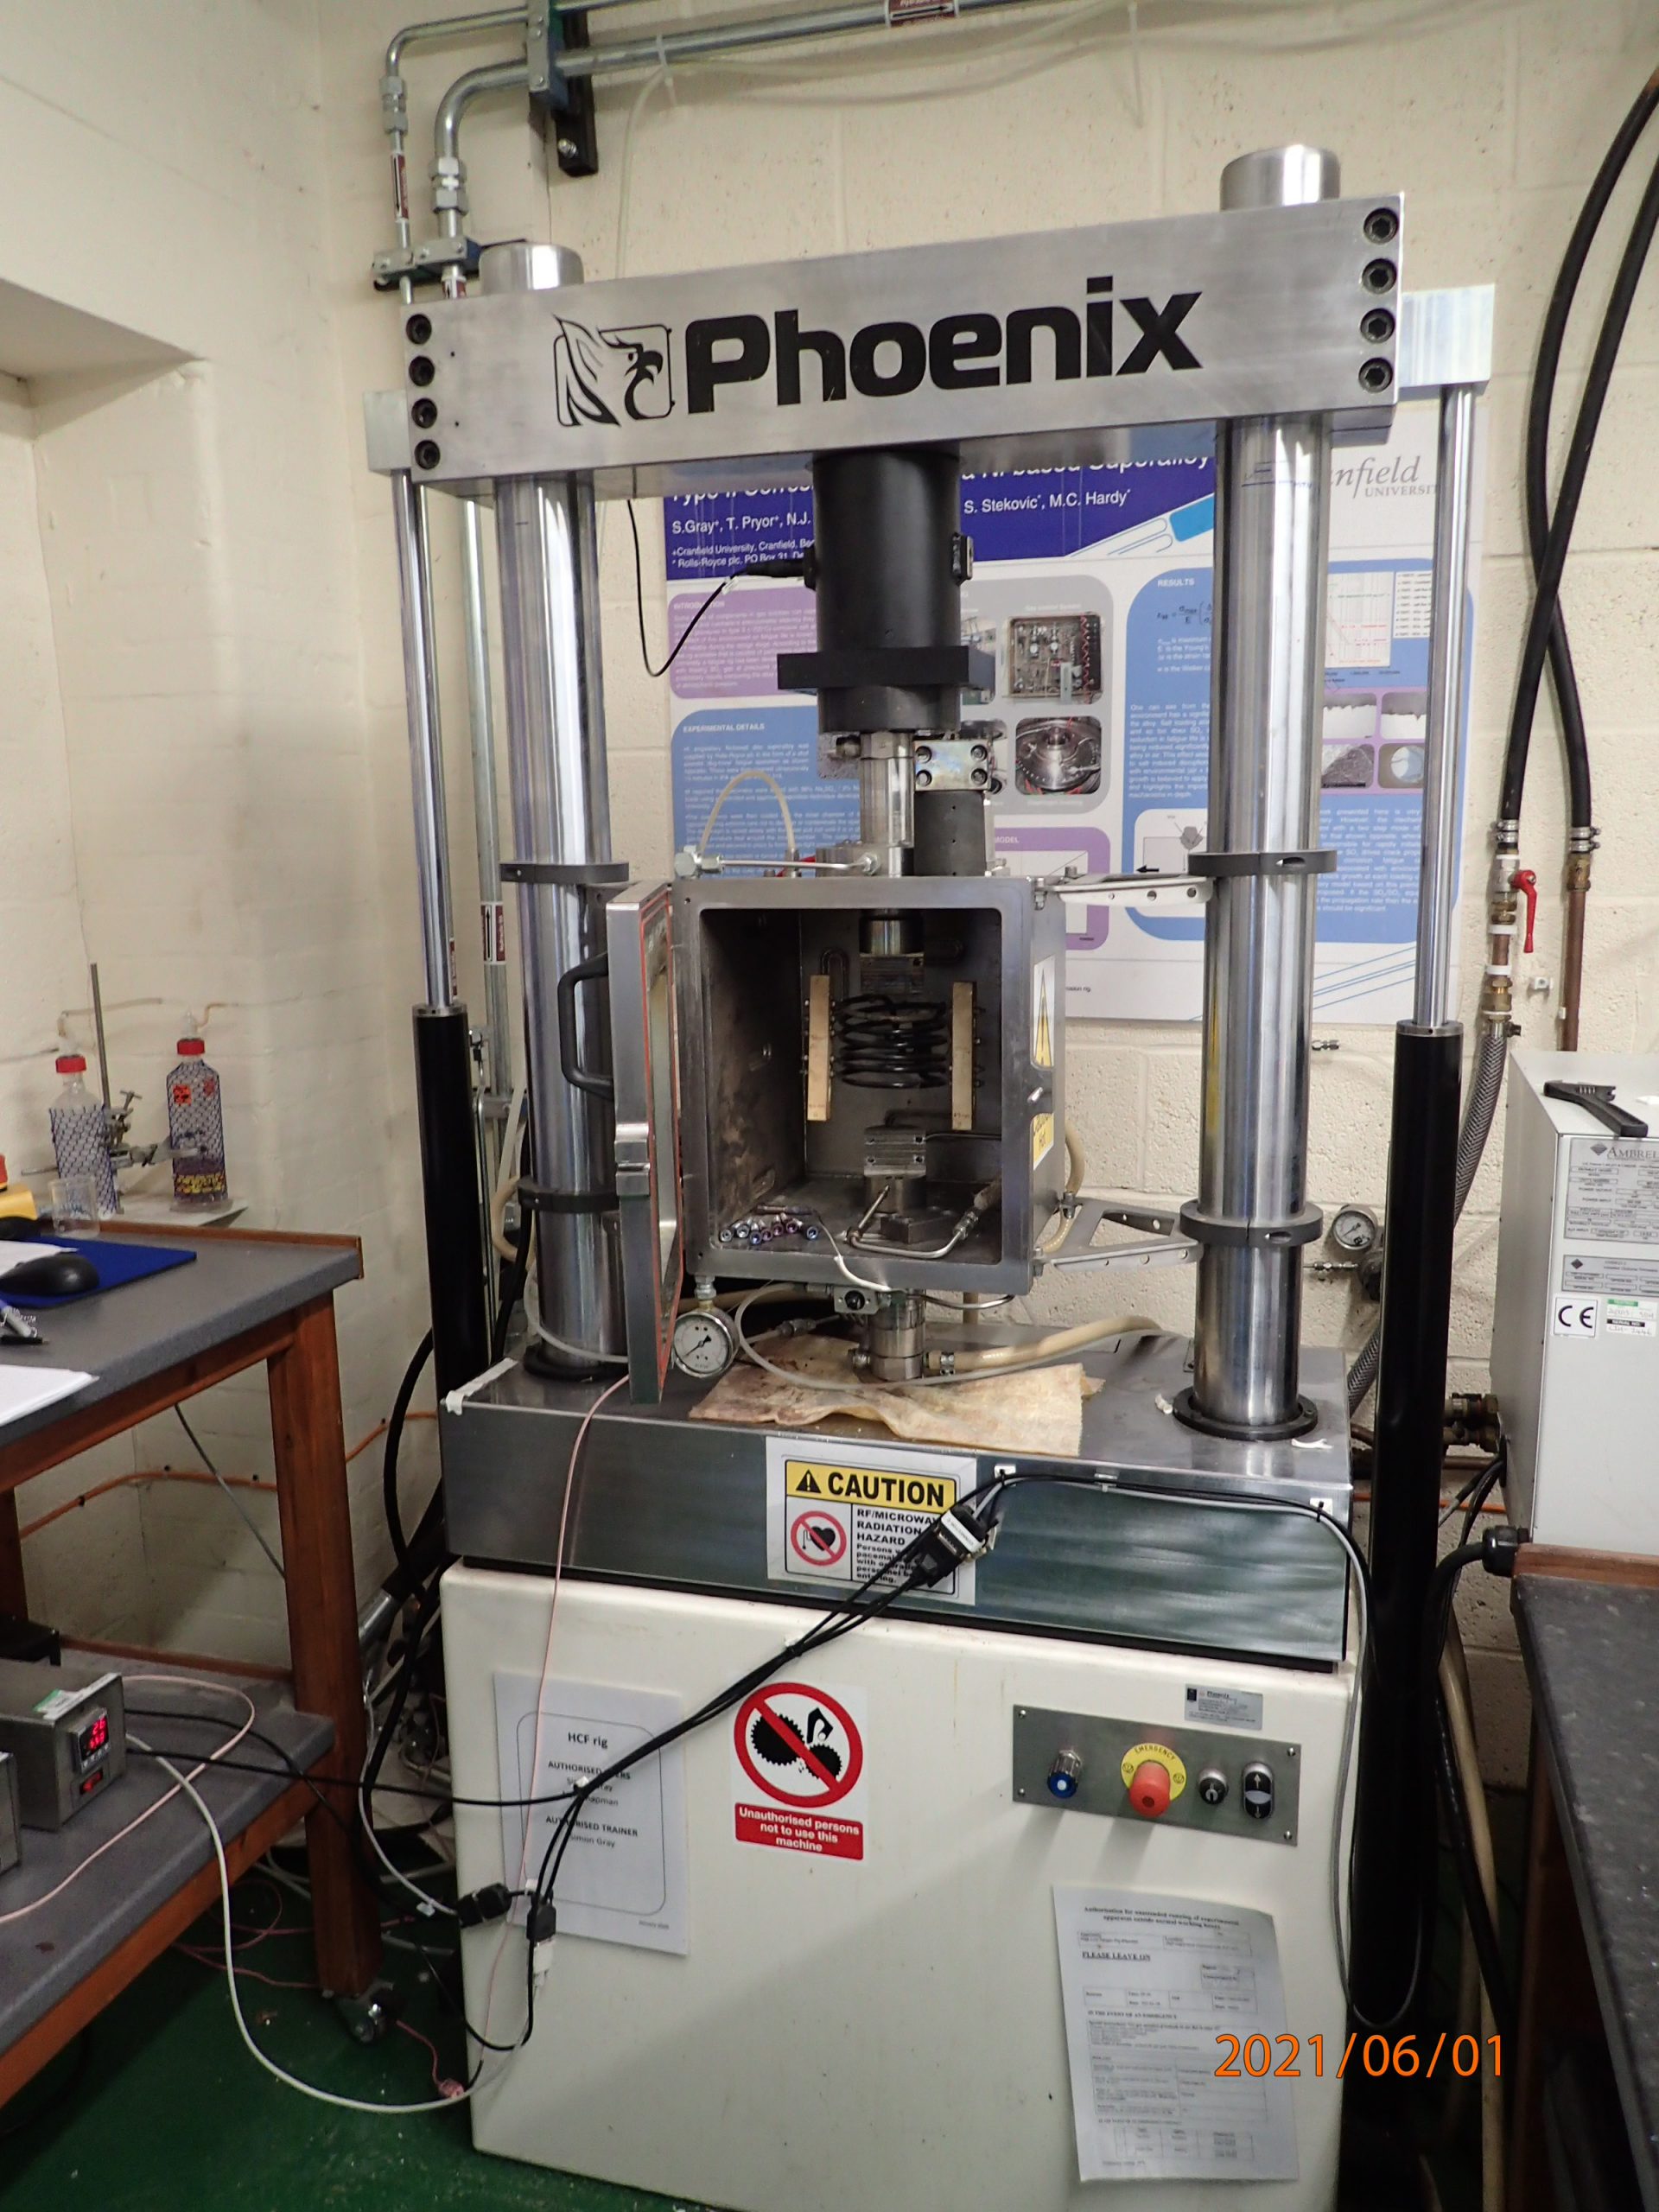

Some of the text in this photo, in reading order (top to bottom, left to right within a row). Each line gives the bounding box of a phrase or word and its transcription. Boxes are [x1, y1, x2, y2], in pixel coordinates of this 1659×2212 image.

[686, 276, 1204, 415] Phoenix
[1330, 456, 1421, 499] nfield
[963, 500, 977, 514] S.
[1050, 492, 1081, 508] M.C.
[726, 517, 739, 530] T.
[786, 512, 810, 526] N.J.
[1157, 578, 1195, 588] RESULTS
[827, 1471, 944, 1509] CAUTION
[856, 1520, 923, 1535] RADIATION
[856, 1532, 906, 1546] HAZARD
[856, 1542, 893, 1554] Persons
[568, 1732, 608, 1749] HCF rig
[1135, 1744, 1176, 1762] EMERGENCY
[548, 1760, 603, 1775] AUTHORISED
[739, 1806, 860, 1835] Unauthorised persons
[602, 1824, 638, 1837] TRAINER
[760, 1822, 839, 1844] not to use this
[776, 1836, 823, 1853] machine
[1082, 1951, 1110, 1961] PLEASE
[1112, 1953, 1138, 1961] LEAVE
